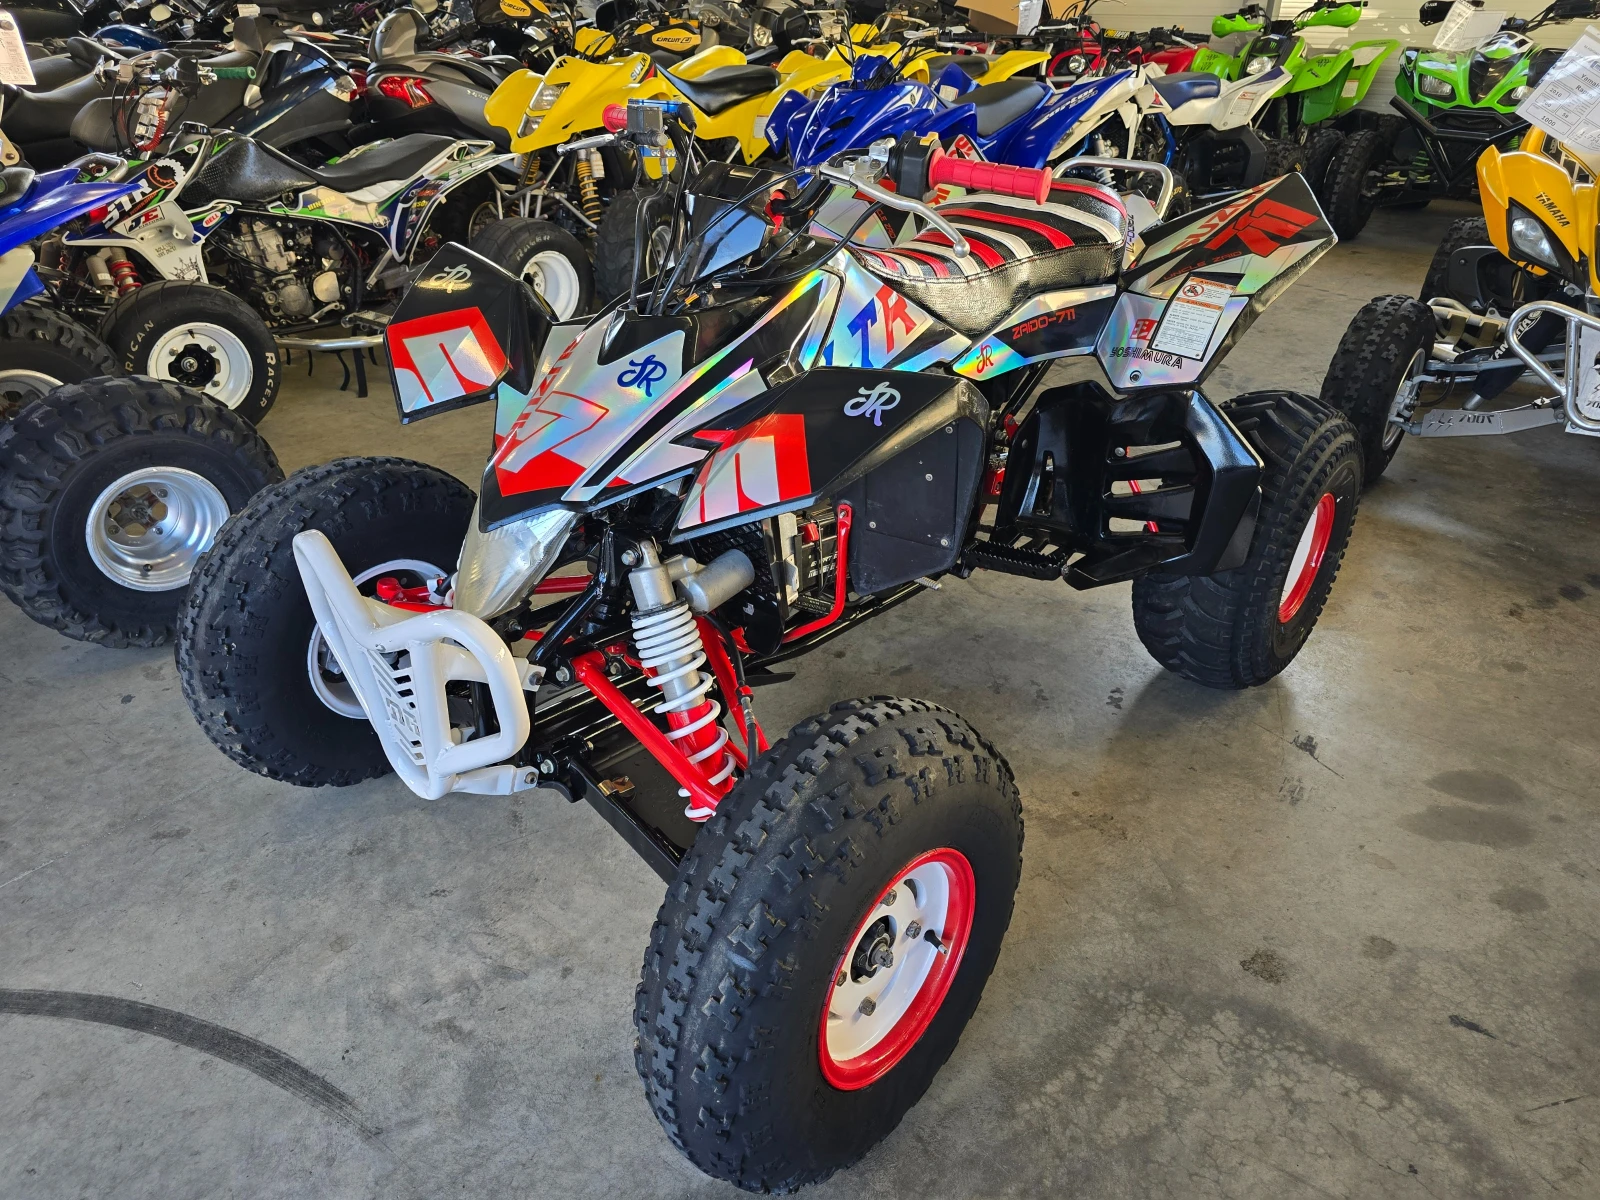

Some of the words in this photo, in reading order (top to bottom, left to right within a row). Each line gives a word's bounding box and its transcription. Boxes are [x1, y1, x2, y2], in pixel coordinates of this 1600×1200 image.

[630, 55, 649, 80] SUZUKI
[1580, 73, 1600, 89] Yamah
[128, 208, 159, 232] JE
[205, 214, 219, 226] BELL
[1535, 192, 1571, 228] YAMAHA
[1163, 260, 1206, 281] UNCLE
[1109, 346, 1183, 370] YOSHIMURA
[260, 352, 277, 408] RACER
